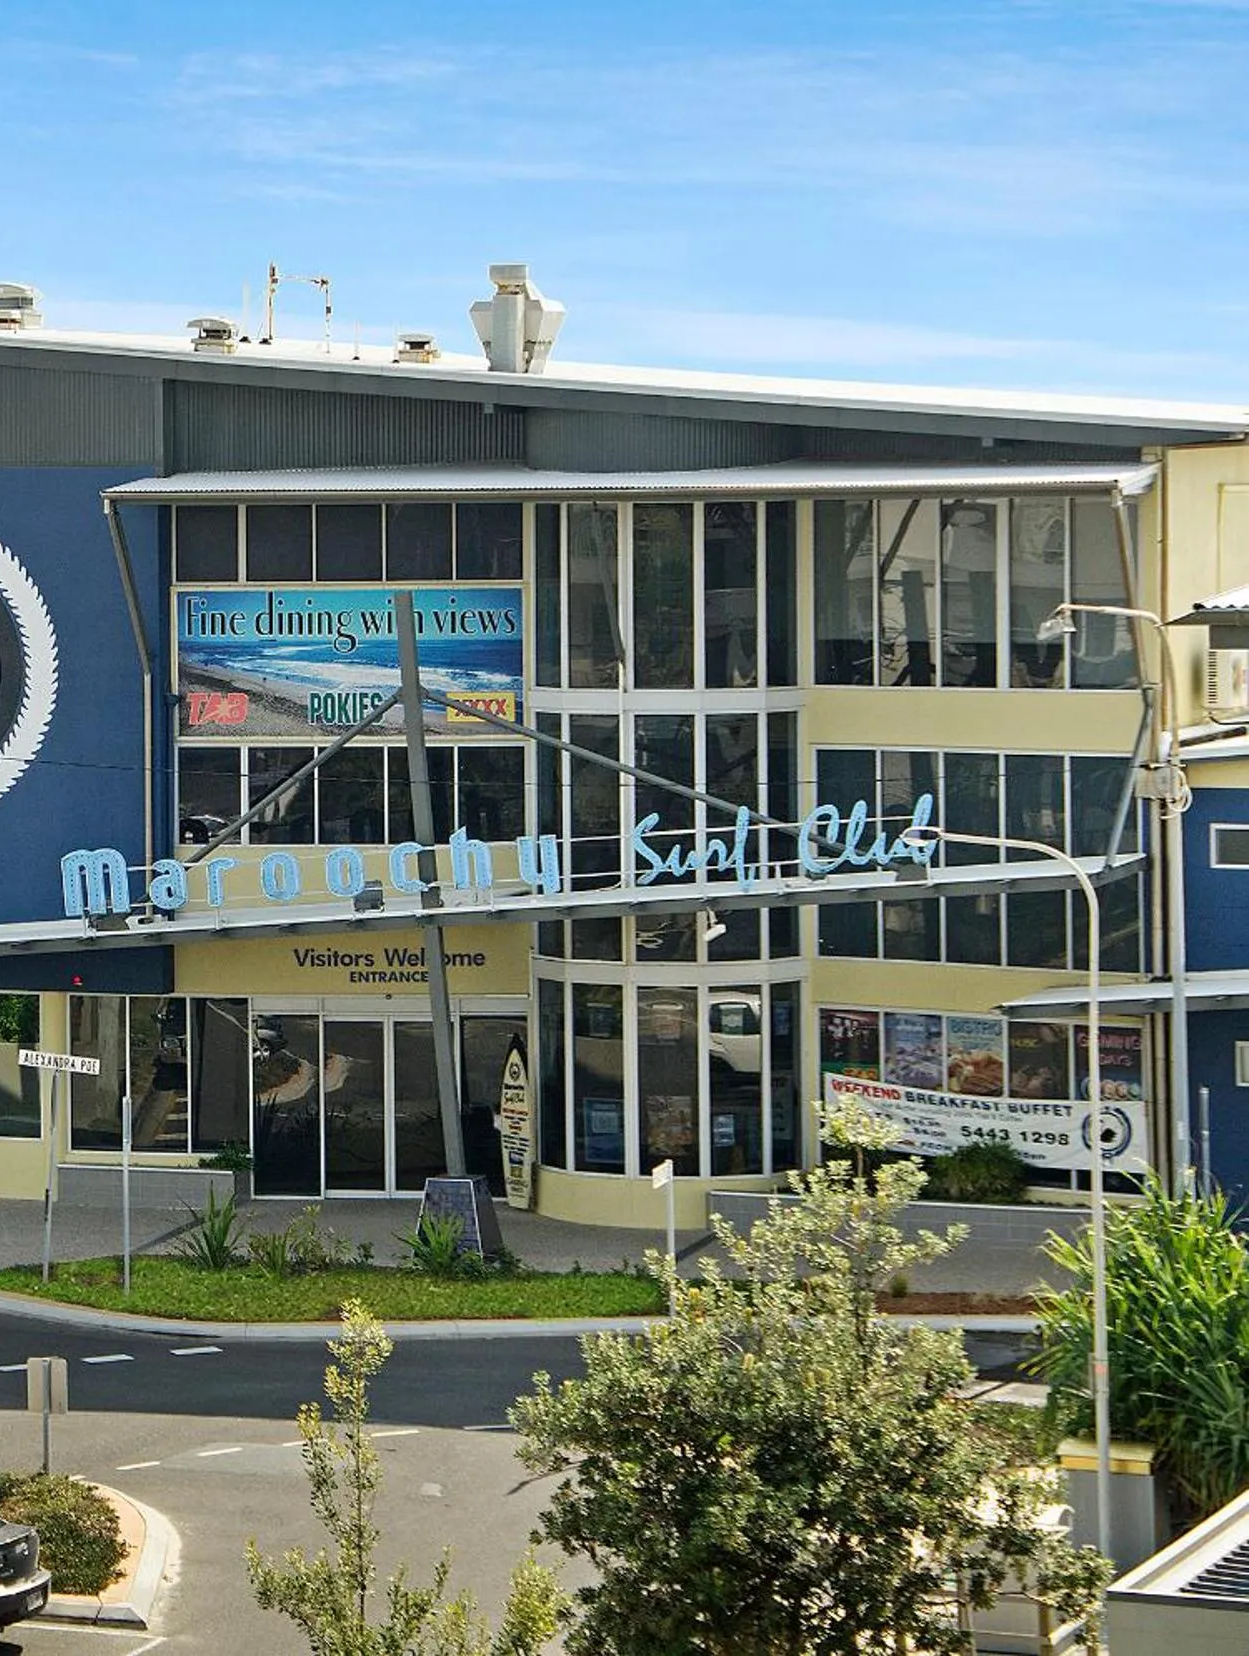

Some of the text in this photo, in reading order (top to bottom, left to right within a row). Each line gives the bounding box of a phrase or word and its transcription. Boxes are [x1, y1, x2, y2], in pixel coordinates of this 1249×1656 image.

[185, 591, 516, 653] Fine dining wih views
[308, 691, 385, 726] POKIES
[631, 793, 936, 893] Surf Club
[60, 826, 562, 917] maroochy
[293, 947, 486, 967] Visitors Welome
[350, 971, 429, 983] ENTRANCE
[23, 1052, 77, 1070] ALEXANDRA
[831, 1078, 902, 1101] WEEKEND
[905, 1091, 1002, 1113] BREAKFAST
[1008, 1102, 1073, 1118] BUFFET
[961, 1125, 1011, 1142] 5443
[1019, 1131, 1071, 1146] 1298
